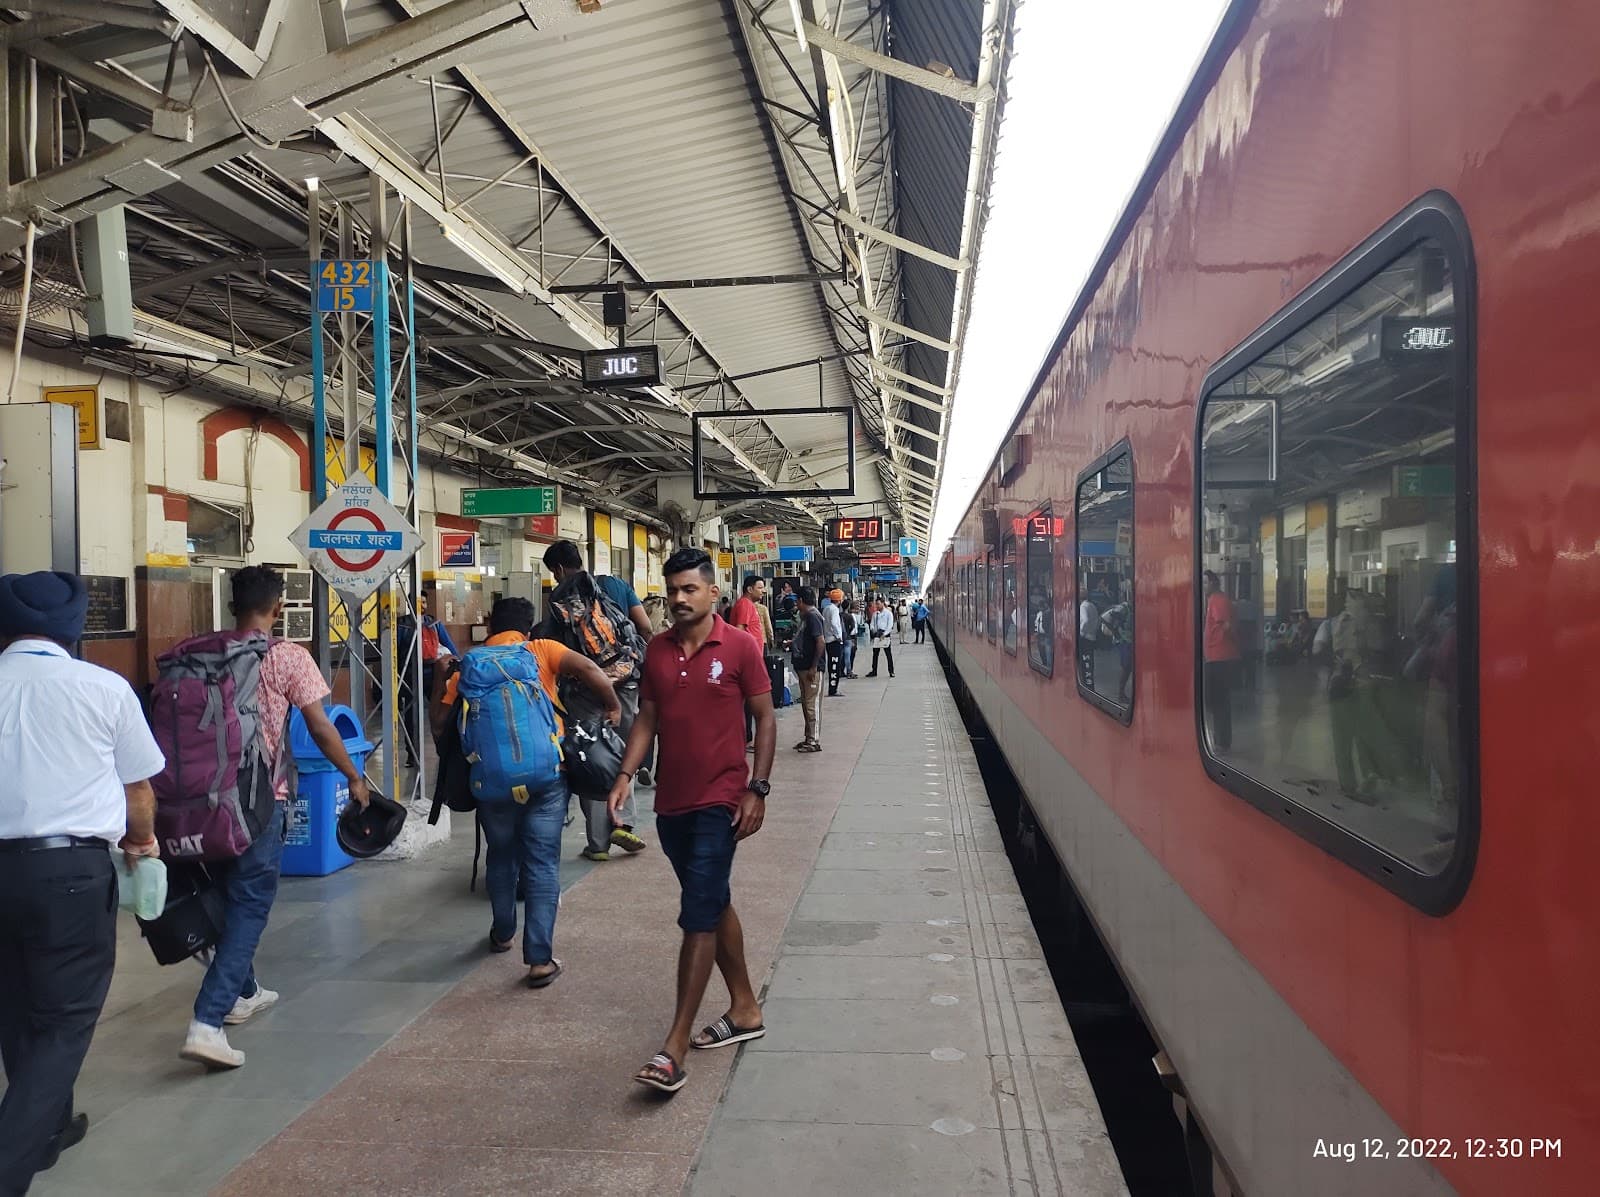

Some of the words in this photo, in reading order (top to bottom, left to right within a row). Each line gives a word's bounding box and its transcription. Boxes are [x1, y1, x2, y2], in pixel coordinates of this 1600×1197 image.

[321, 262, 370, 285] 432
[334, 287, 355, 310] 15
[602, 357, 638, 376] JUC
[840, 521, 854, 539] 12
[857, 520, 879, 538] 30
[367, 534, 393, 546] शहर
[904, 540, 911, 554] 1
[165, 833, 204, 857] CAT
